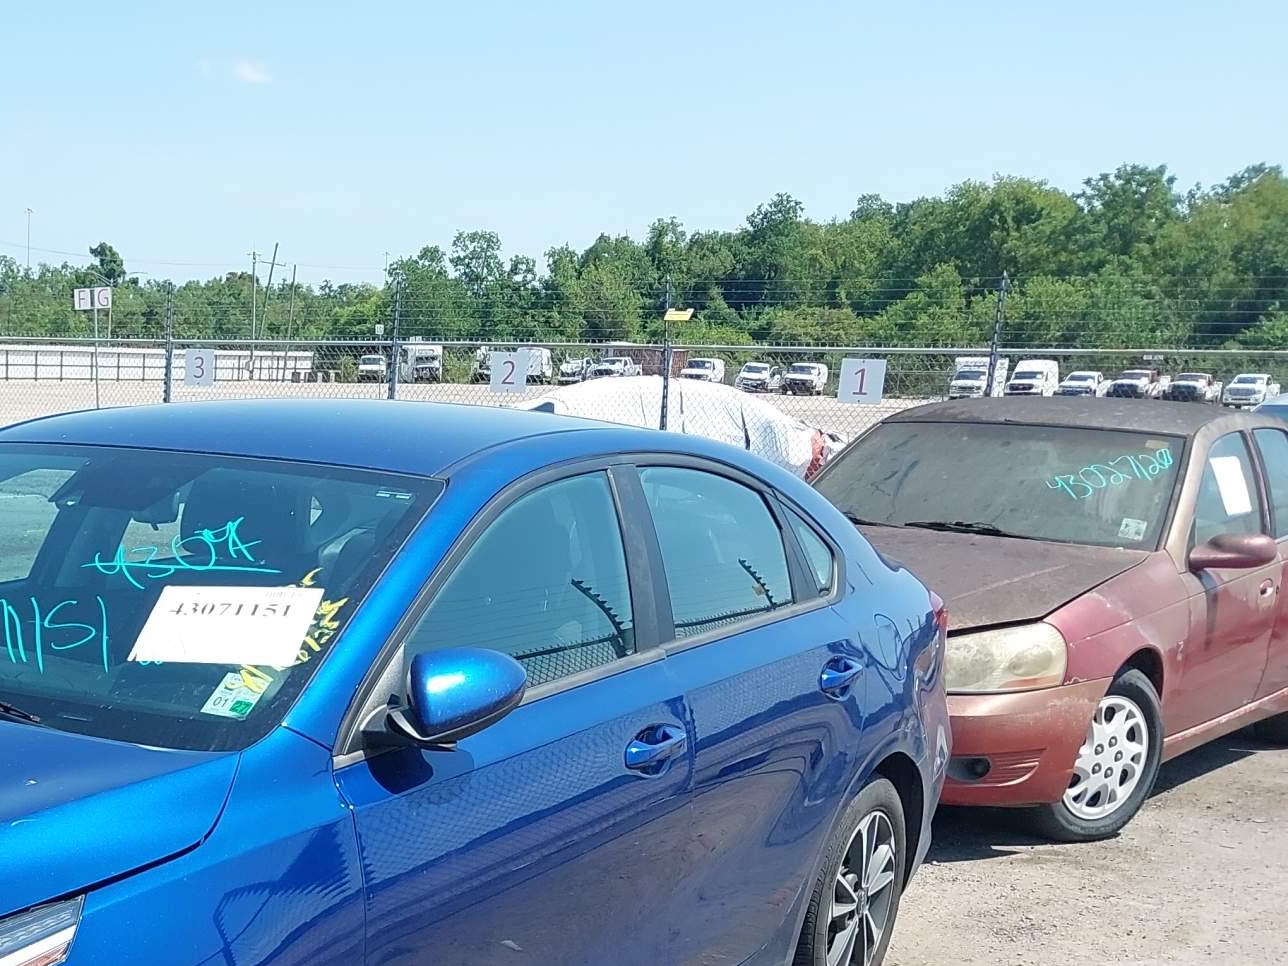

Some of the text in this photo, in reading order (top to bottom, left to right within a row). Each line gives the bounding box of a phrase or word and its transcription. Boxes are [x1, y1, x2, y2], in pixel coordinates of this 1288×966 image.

[78, 288, 109, 309] F G
[193, 356, 205, 379] 3
[501, 360, 515, 385] 2
[852, 368, 868, 396] 1
[169, 602, 292, 617] 43071151
[213, 696, 229, 708] 01
